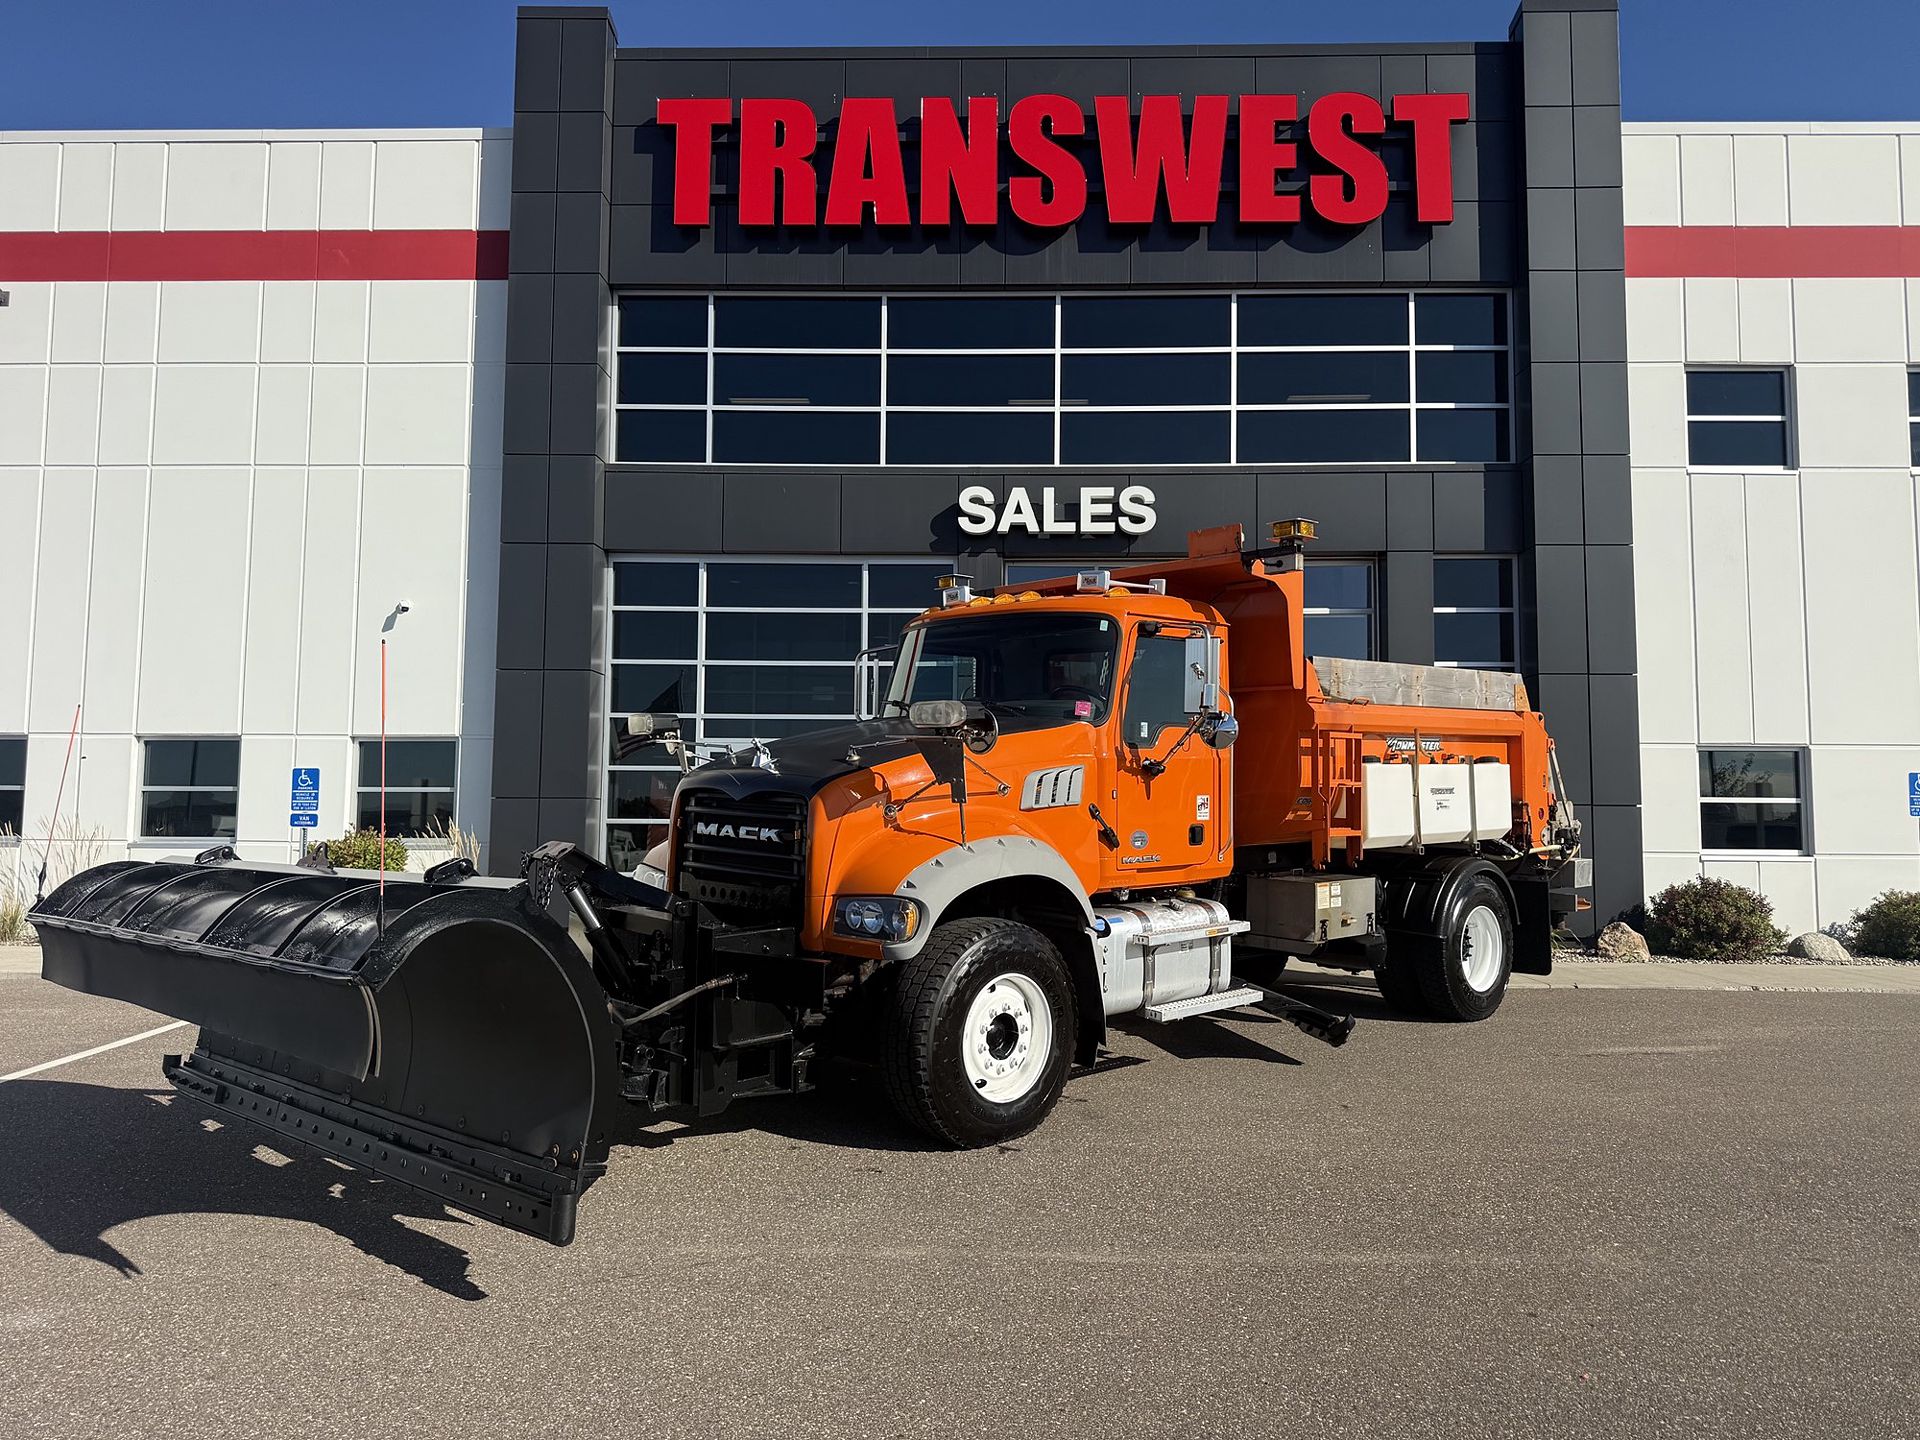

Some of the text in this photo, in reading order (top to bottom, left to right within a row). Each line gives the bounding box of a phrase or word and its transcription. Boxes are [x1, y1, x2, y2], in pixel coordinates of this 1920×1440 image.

[656, 93, 1470, 227] TRANSWEST
[957, 485, 1157, 535] SALES
[1386, 737, 1441, 752] TOWMSTER
[696, 821, 783, 843] MACK
